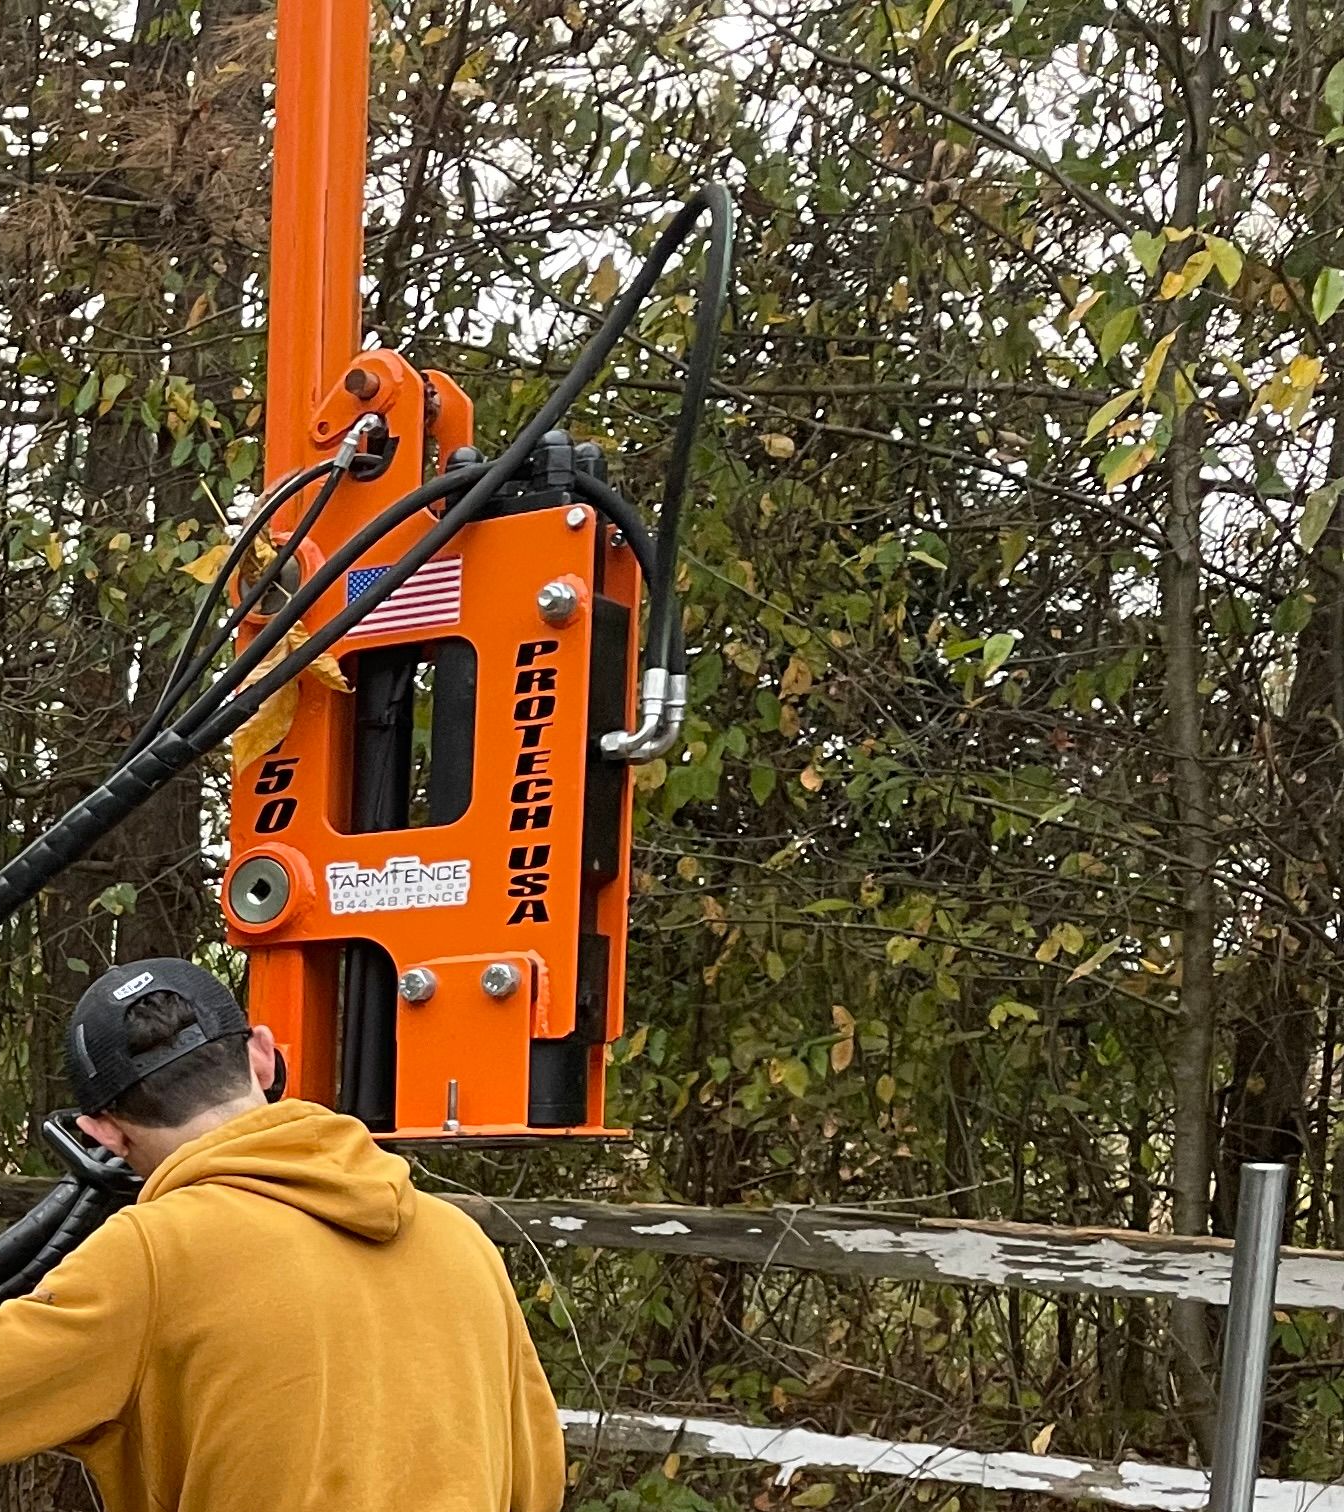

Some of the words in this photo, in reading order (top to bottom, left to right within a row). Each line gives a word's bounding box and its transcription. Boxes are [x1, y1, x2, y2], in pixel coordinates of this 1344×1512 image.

[510, 640, 559, 831] PROTECH
[254, 739, 300, 834] 50
[506, 844, 551, 925] USA
